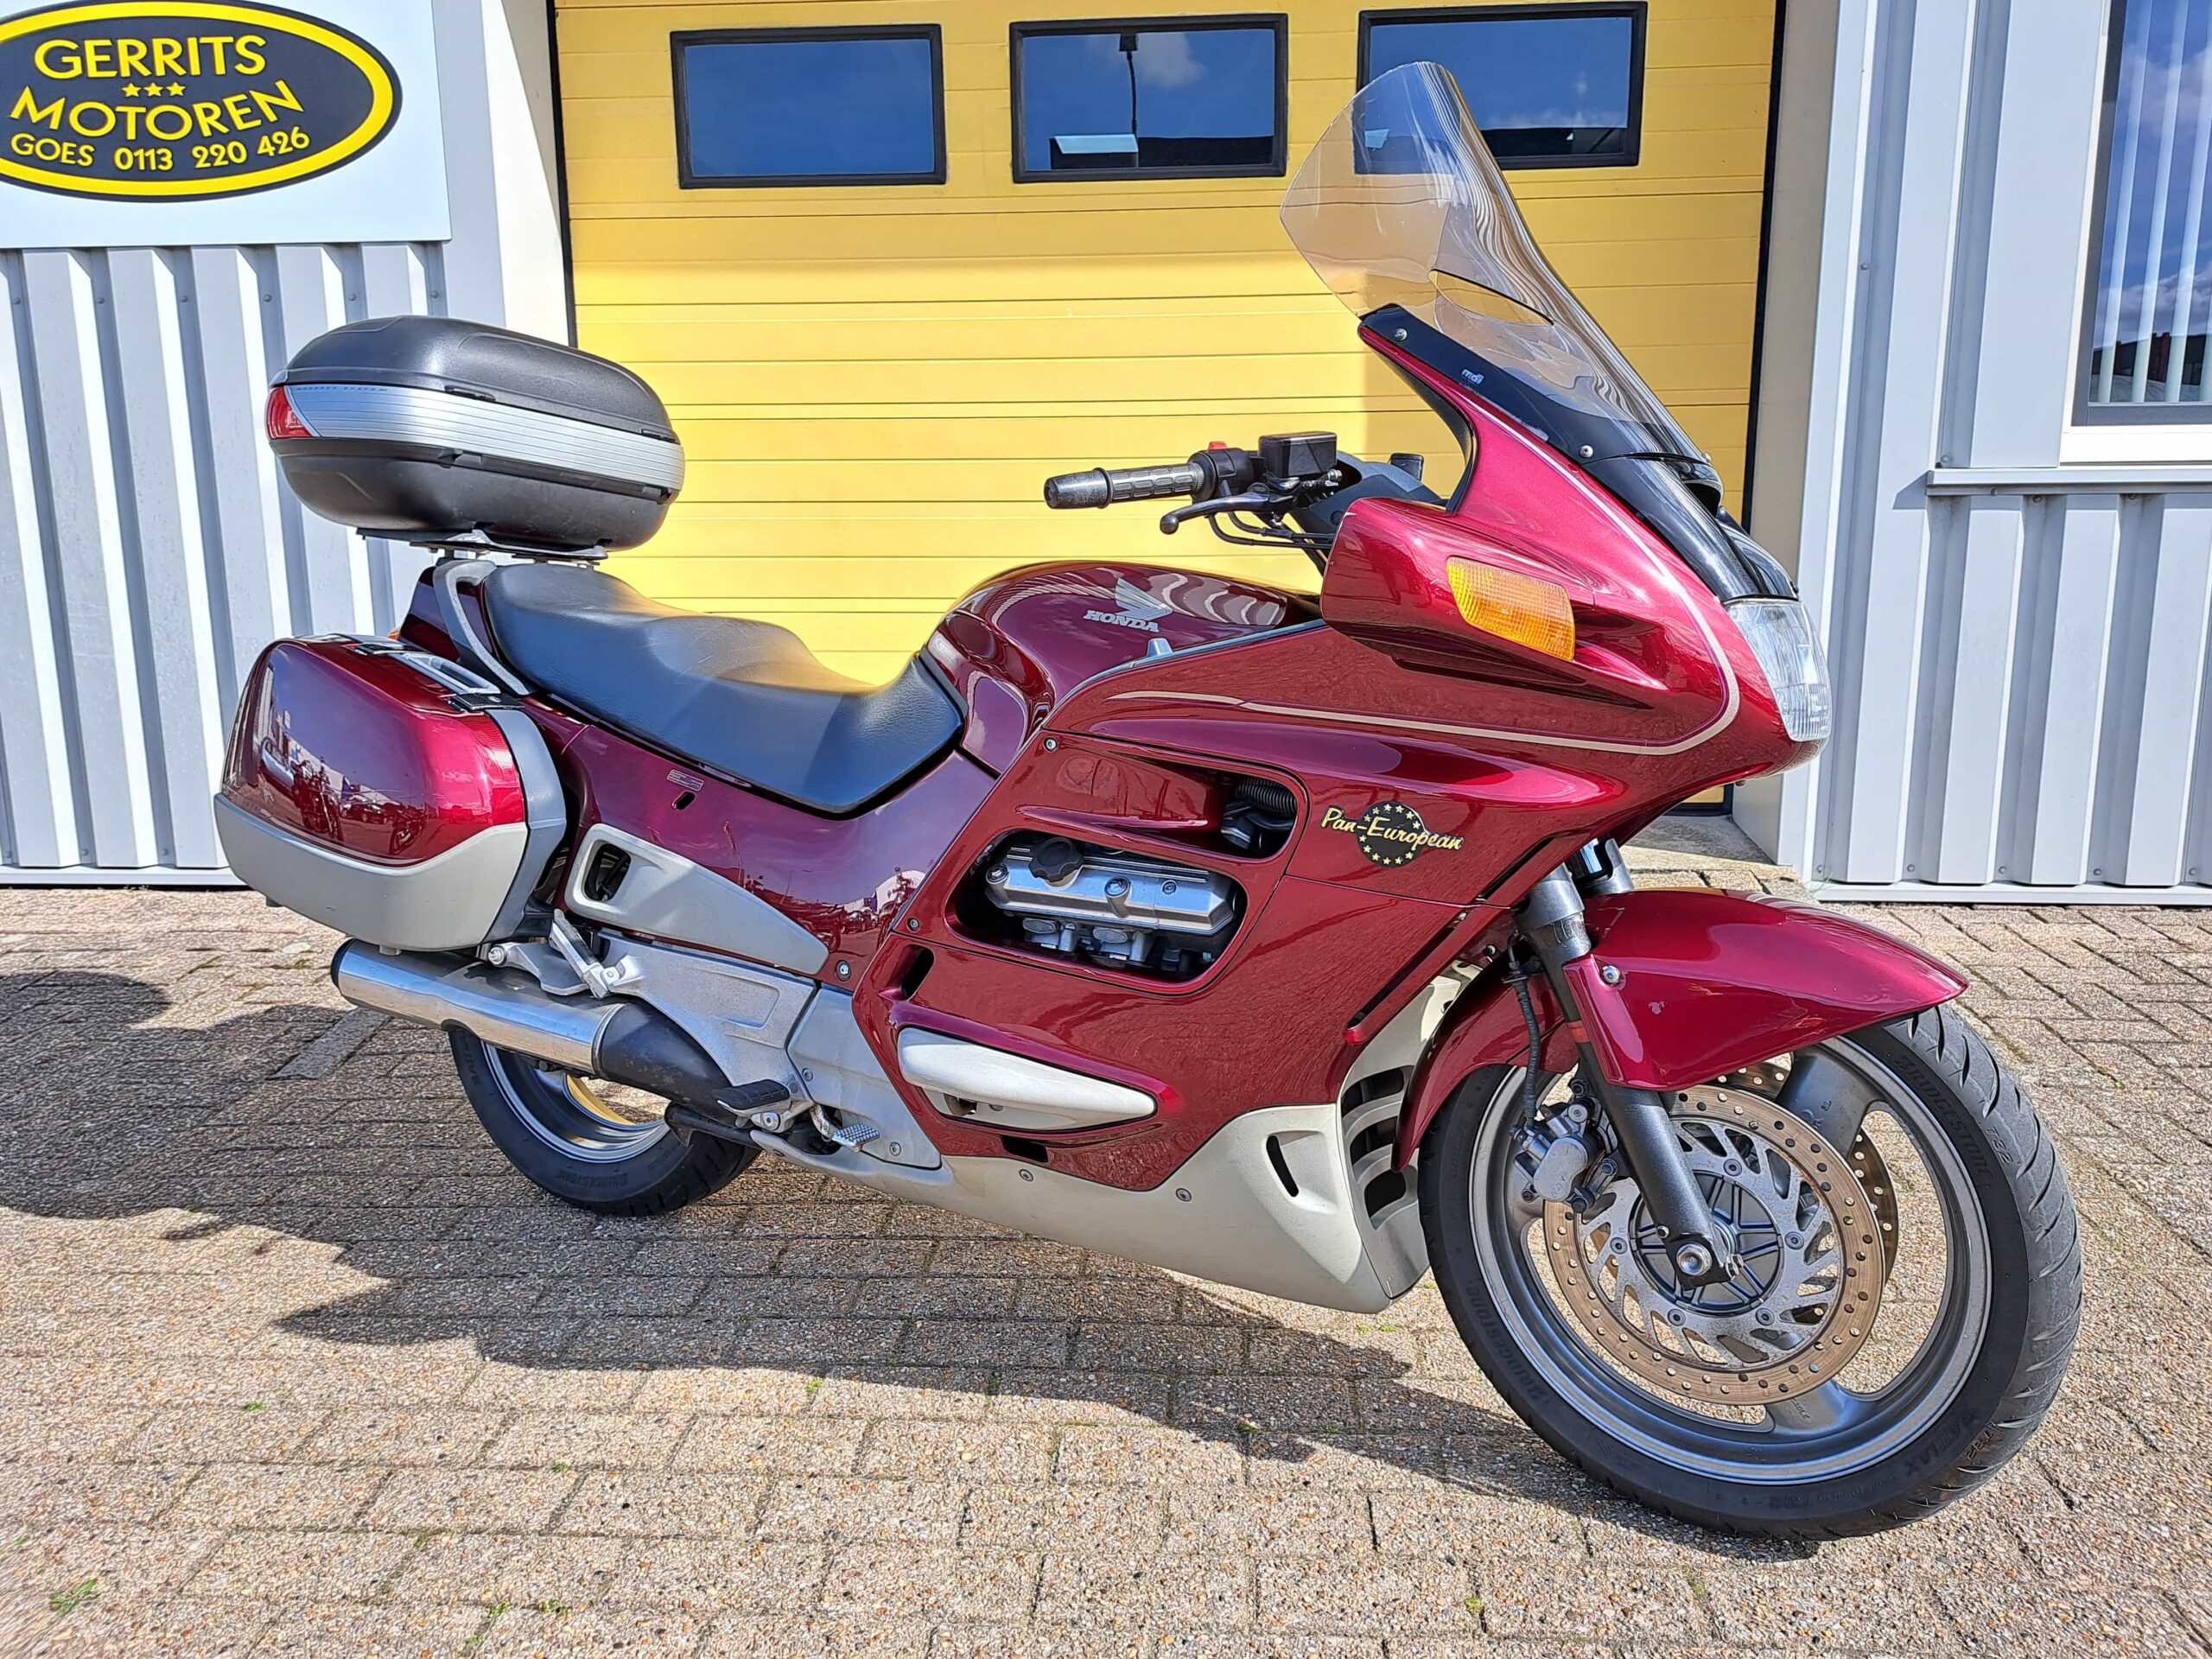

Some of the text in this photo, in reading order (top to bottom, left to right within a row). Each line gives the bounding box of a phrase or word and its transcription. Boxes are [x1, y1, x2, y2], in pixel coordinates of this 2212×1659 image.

[35, 35, 267, 79] GERRITS
[10, 79, 305, 141] MOTOREN
[10, 126, 310, 171] GOES 0113 220 426
[1083, 609, 1160, 632] HONDA
[1321, 807, 1463, 851] Pan-European
[1893, 1054, 1993, 1179] BRIDGESTONE
[1985, 1126, 2014, 1165] T32
